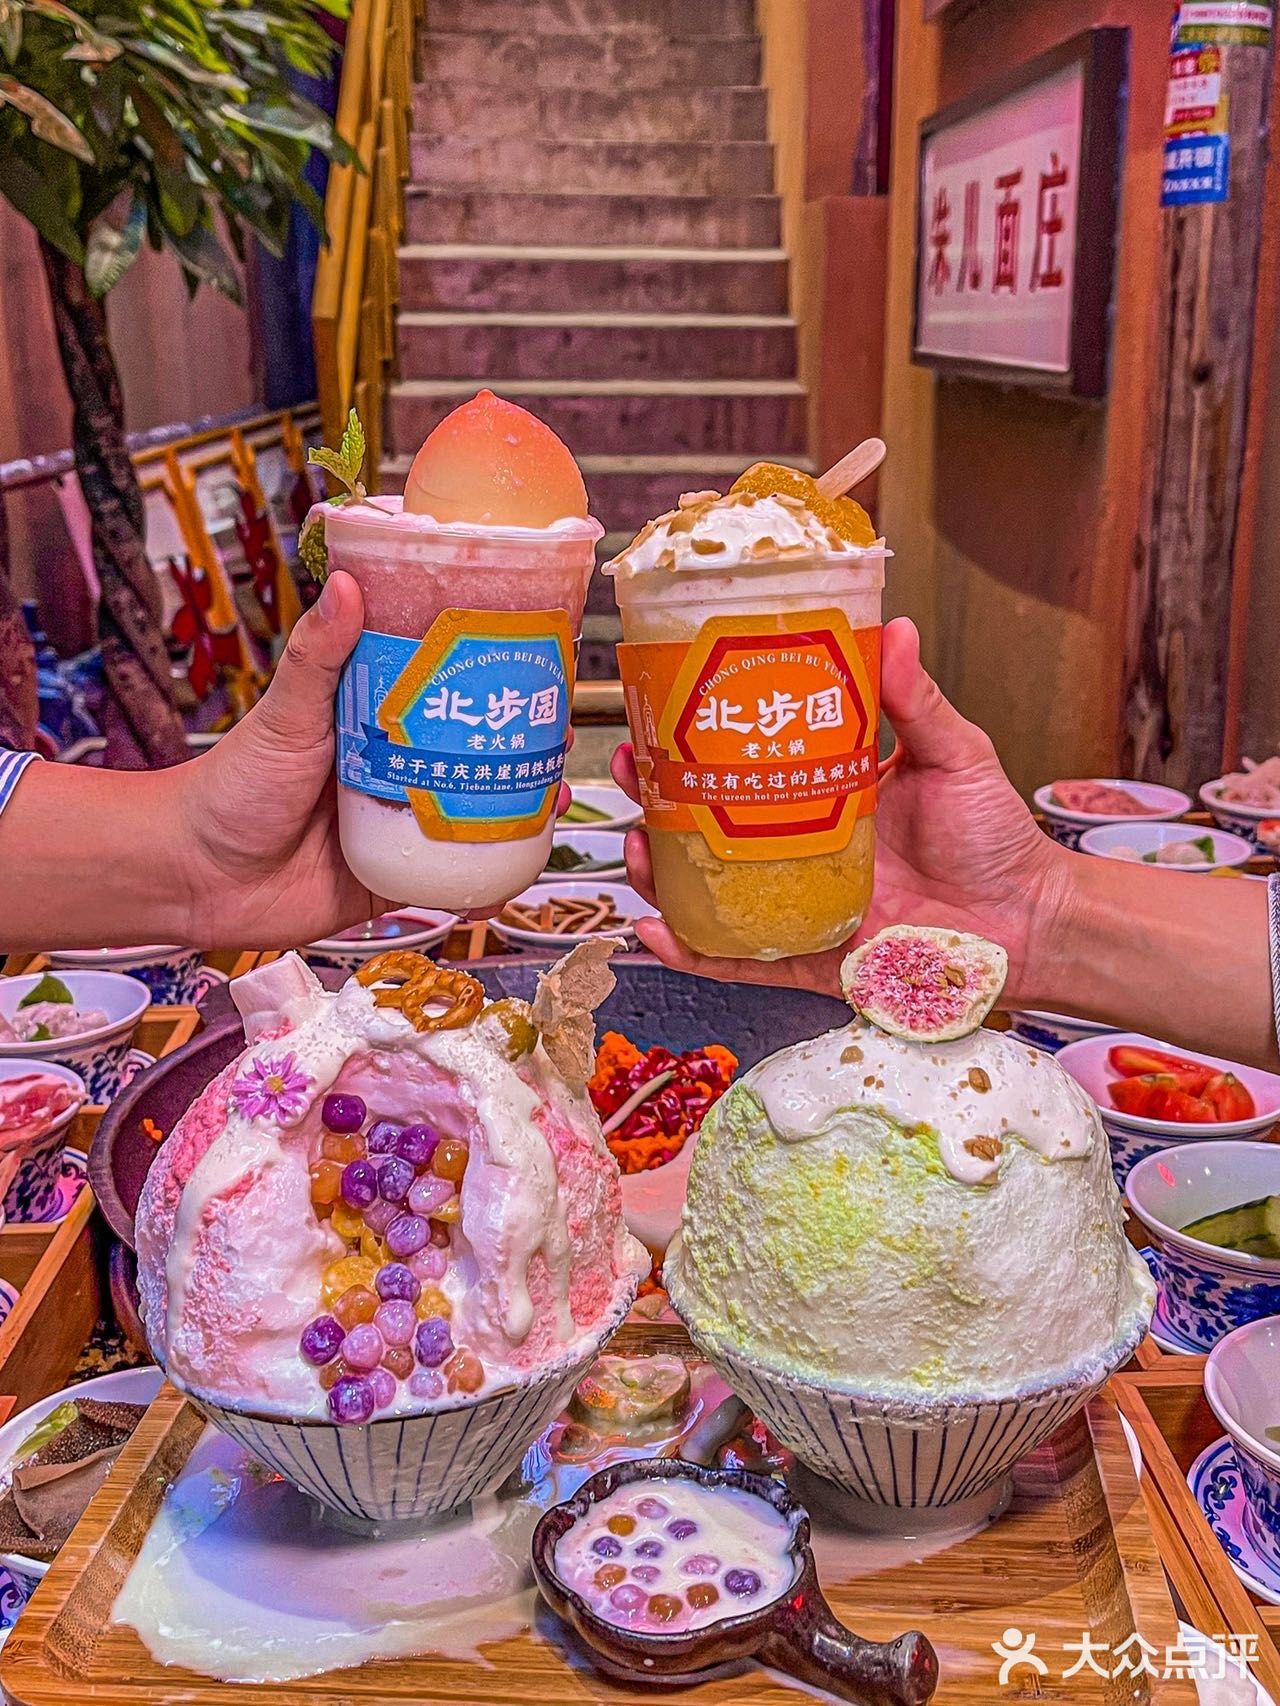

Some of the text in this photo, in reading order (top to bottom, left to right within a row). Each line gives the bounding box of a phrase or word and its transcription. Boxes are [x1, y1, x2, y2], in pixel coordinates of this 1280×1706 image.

[431, 657, 474, 686] CHONG
[478, 651, 510, 666] QING
[514, 651, 533, 662] BEI
[534, 655, 549, 667] BU
[699, 652, 849, 696] CHONG QING BEI BU YUAN
[423, 684, 560, 731] 北步园
[695, 685, 845, 737] 北步园
[467, 732, 526, 750] 老火锅
[741, 738, 806, 759] 老火锅
[387, 770, 418, 786] Started
[421, 778, 430, 787] at
[460, 781, 491, 792] Tieban
[681, 754, 871, 790] 你没有吃过的盖碗火锅
[701, 792, 718, 801] The
[721, 793, 751, 801] tureen
[754, 792, 770, 801] hot
[774, 792, 790, 802] pot
[792, 790, 809, 800] you
[811, 784, 839, 796] haven't
